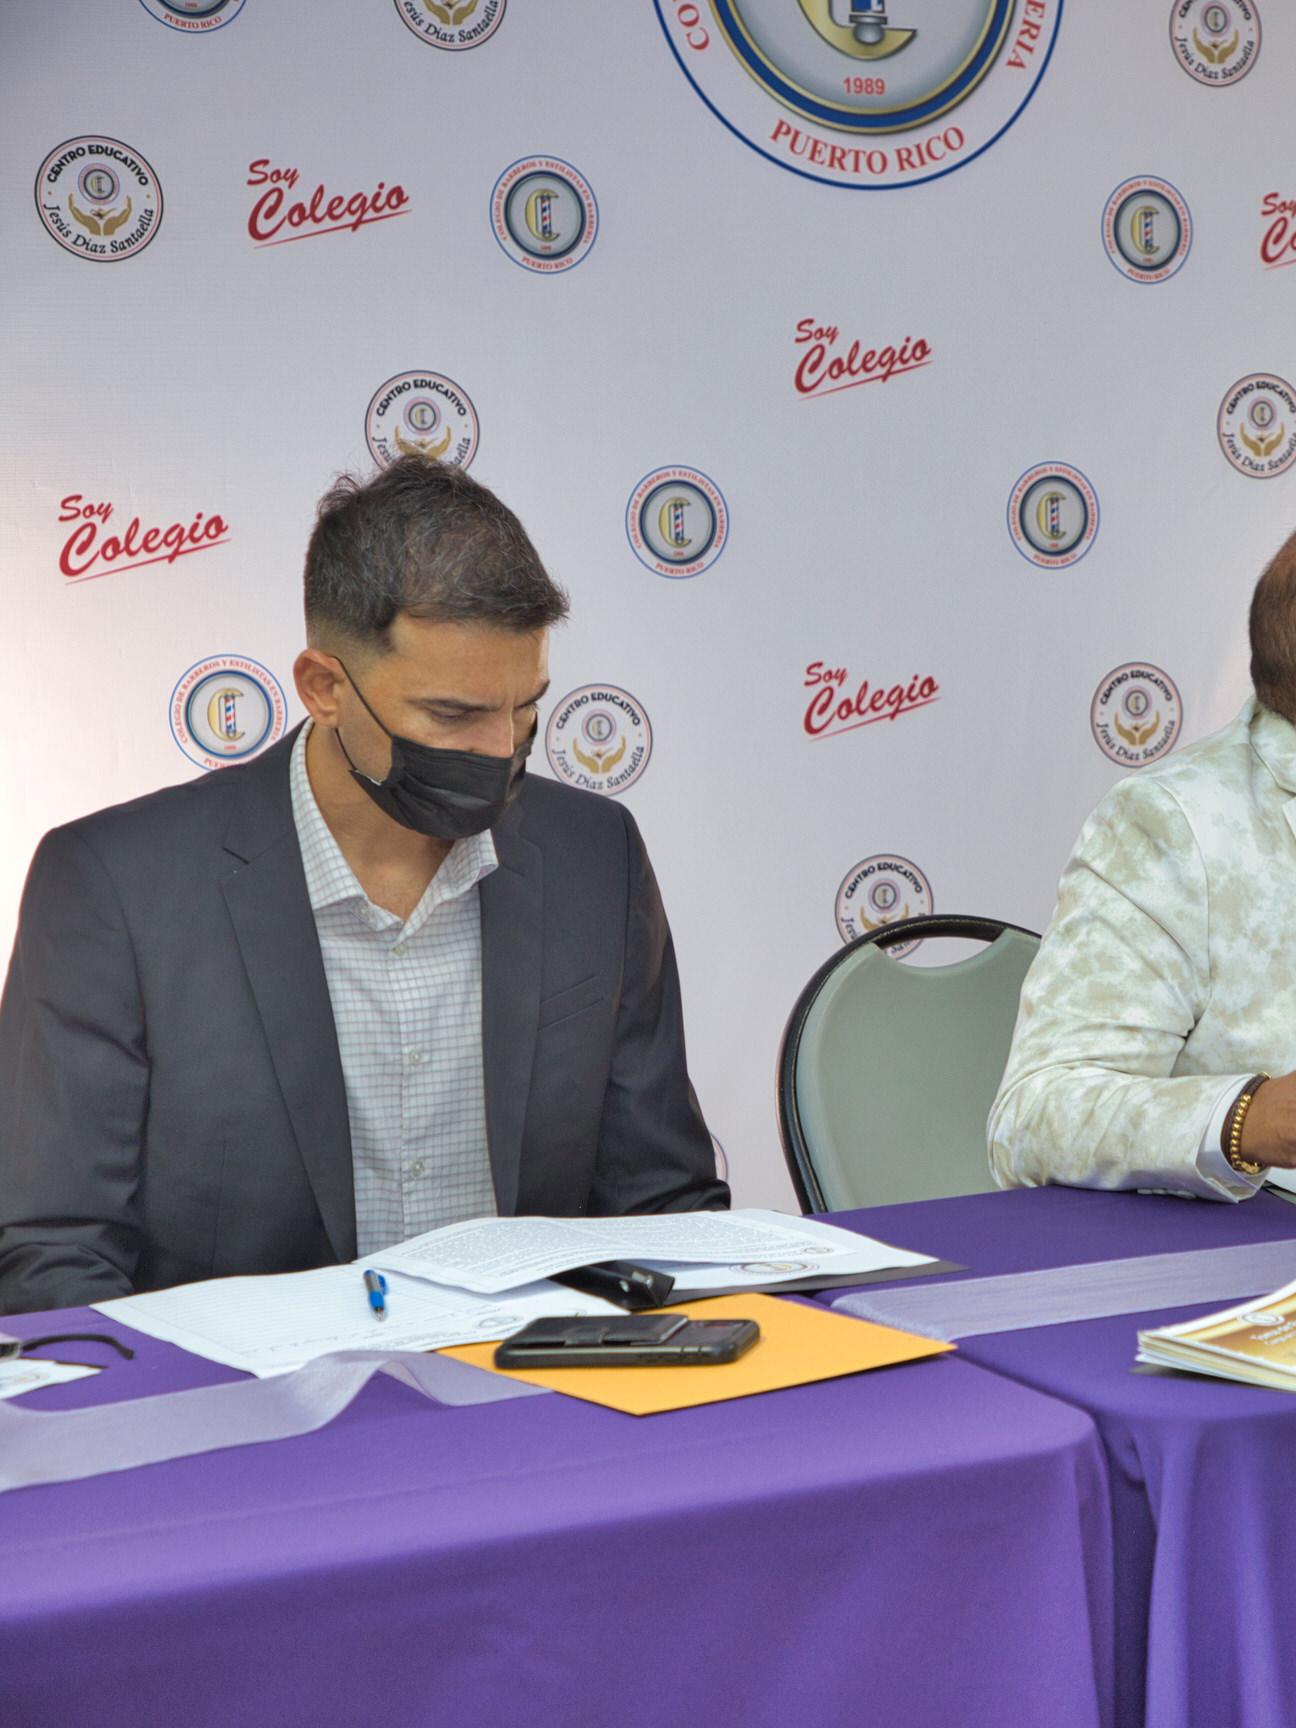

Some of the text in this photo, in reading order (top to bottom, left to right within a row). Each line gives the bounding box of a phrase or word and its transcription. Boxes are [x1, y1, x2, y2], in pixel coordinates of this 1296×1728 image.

[842, 76, 887, 97] 1989
[47, 144, 149, 186] CENTRO EDUCATIVO
[769, 118, 965, 175] PUERTO RICO
[246, 158, 299, 190] Soy
[43, 204, 72, 238] Jesús
[110, 208, 154, 253] Santaella
[247, 181, 410, 241] Colegio
[794, 317, 839, 345] Soy
[794, 336, 932, 394] Colegio
[376, 379, 467, 417] CENTRO EDUCATIVO
[58, 494, 114, 524] Soy
[58, 512, 229, 578] Colegio
[803, 662, 847, 688] Soy
[556, 691, 640, 730] CENTRO EDUCATIVO
[802, 674, 940, 735] Colegio
[844, 865, 876, 899] CENTRO
